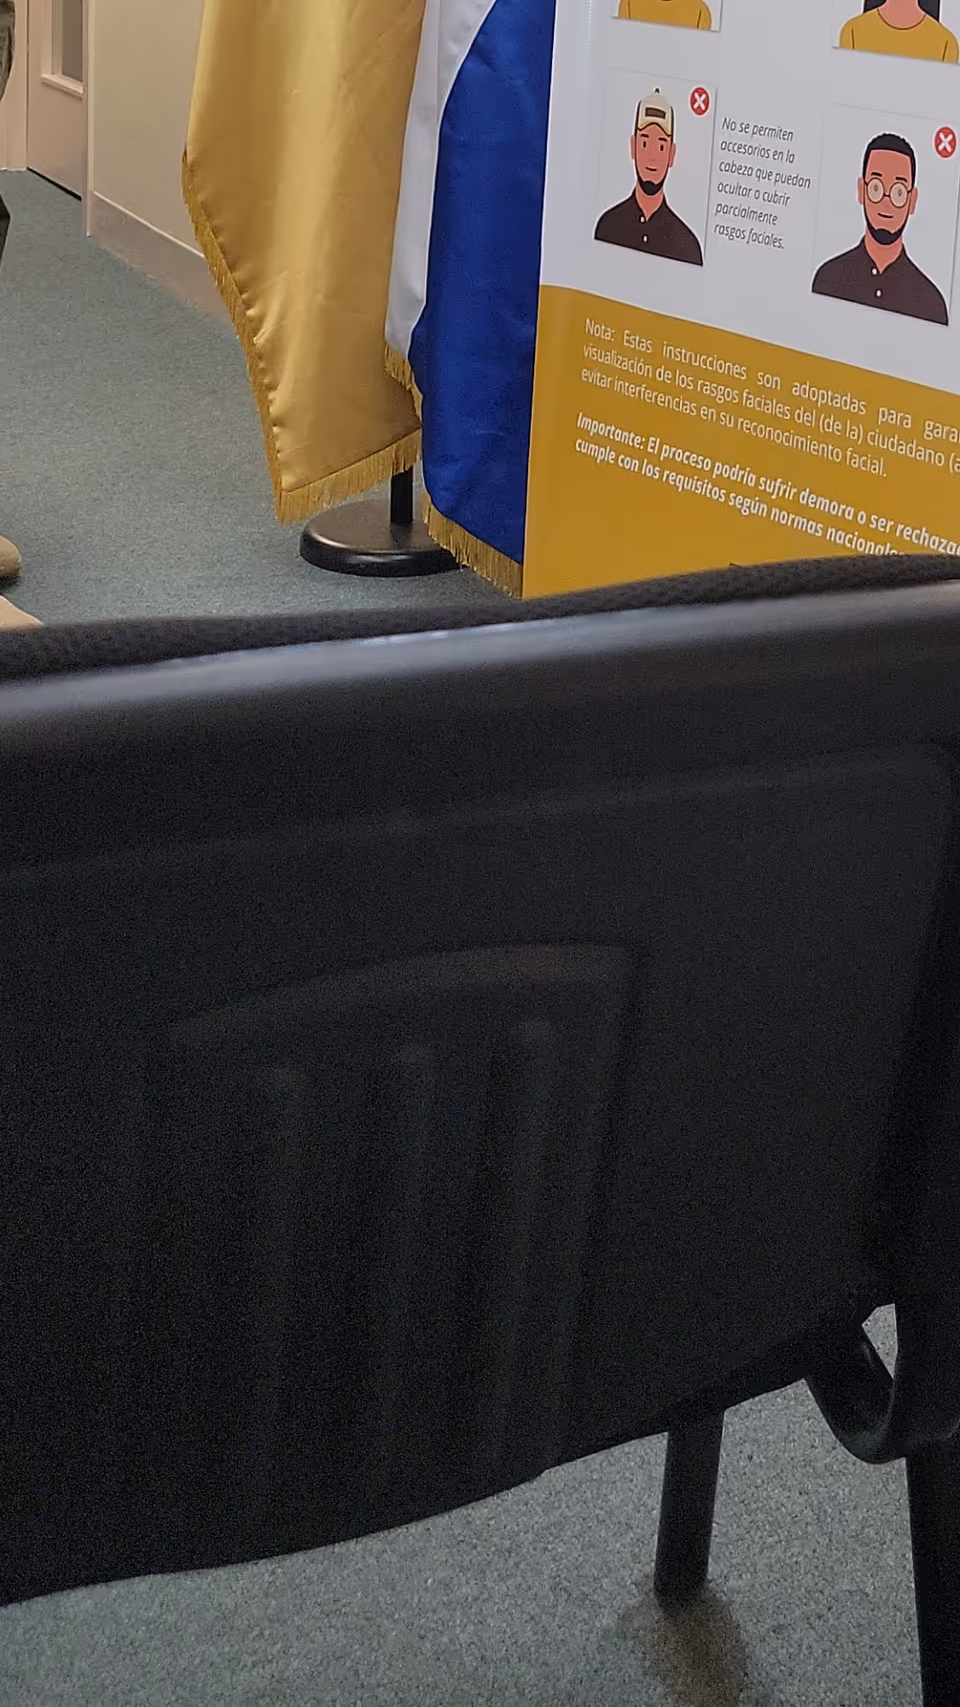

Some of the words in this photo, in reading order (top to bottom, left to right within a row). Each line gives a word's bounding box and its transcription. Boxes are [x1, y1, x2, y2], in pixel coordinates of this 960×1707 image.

[721, 117, 737, 132] No
[739, 121, 750, 134] se
[751, 124, 794, 142] permiten
[720, 140, 771, 159] accesorios
[719, 160, 754, 177] cabeza
[774, 171, 811, 189] puedan
[717, 181, 753, 198] ocultar
[762, 190, 791, 206] cubrir
[714, 202, 778, 226] parcialmente
[713, 223, 747, 241] rasgos
[746, 228, 784, 249] faciales.
[585, 318, 616, 342] Nota:
[623, 330, 653, 353] Estas
[662, 341, 748, 380] instrucciones
[757, 371, 781, 390] son
[792, 380, 866, 415] adoptadas
[878, 406, 912, 428] para
[583, 344, 652, 378] visualización
[655, 365, 672, 383] de
[675, 370, 694, 390] los
[696, 379, 740, 404] rasgos
[742, 389, 791, 420] faciales
[794, 405, 816, 427] del
[819, 413, 842, 436] (de
[845, 419, 864, 443] la)
[867, 429, 945, 467] ciudadano
[581, 367, 612, 389] evitar
[614, 376, 698, 416] interferencias
[700, 406, 716, 423] en
[719, 410, 735, 428] su
[737, 416, 843, 463] reconocimiento
[846, 448, 888, 477] facial.
[575, 437, 616, 463] cumple
[617, 452, 639, 473] con
[641, 459, 661, 479] los
[662, 470, 727, 501] requisitos
[728, 492, 768, 516] según
[770, 507, 824, 537] normas
[577, 412, 645, 450] Importante:
[647, 436, 660, 454] El
[660, 444, 712, 472] proceso
[712, 464, 756, 488] podría
[758, 475, 798, 500] sufrir
[799, 488, 855, 520] demora
[857, 510, 867, 524] o
[869, 514, 895, 533] ser
